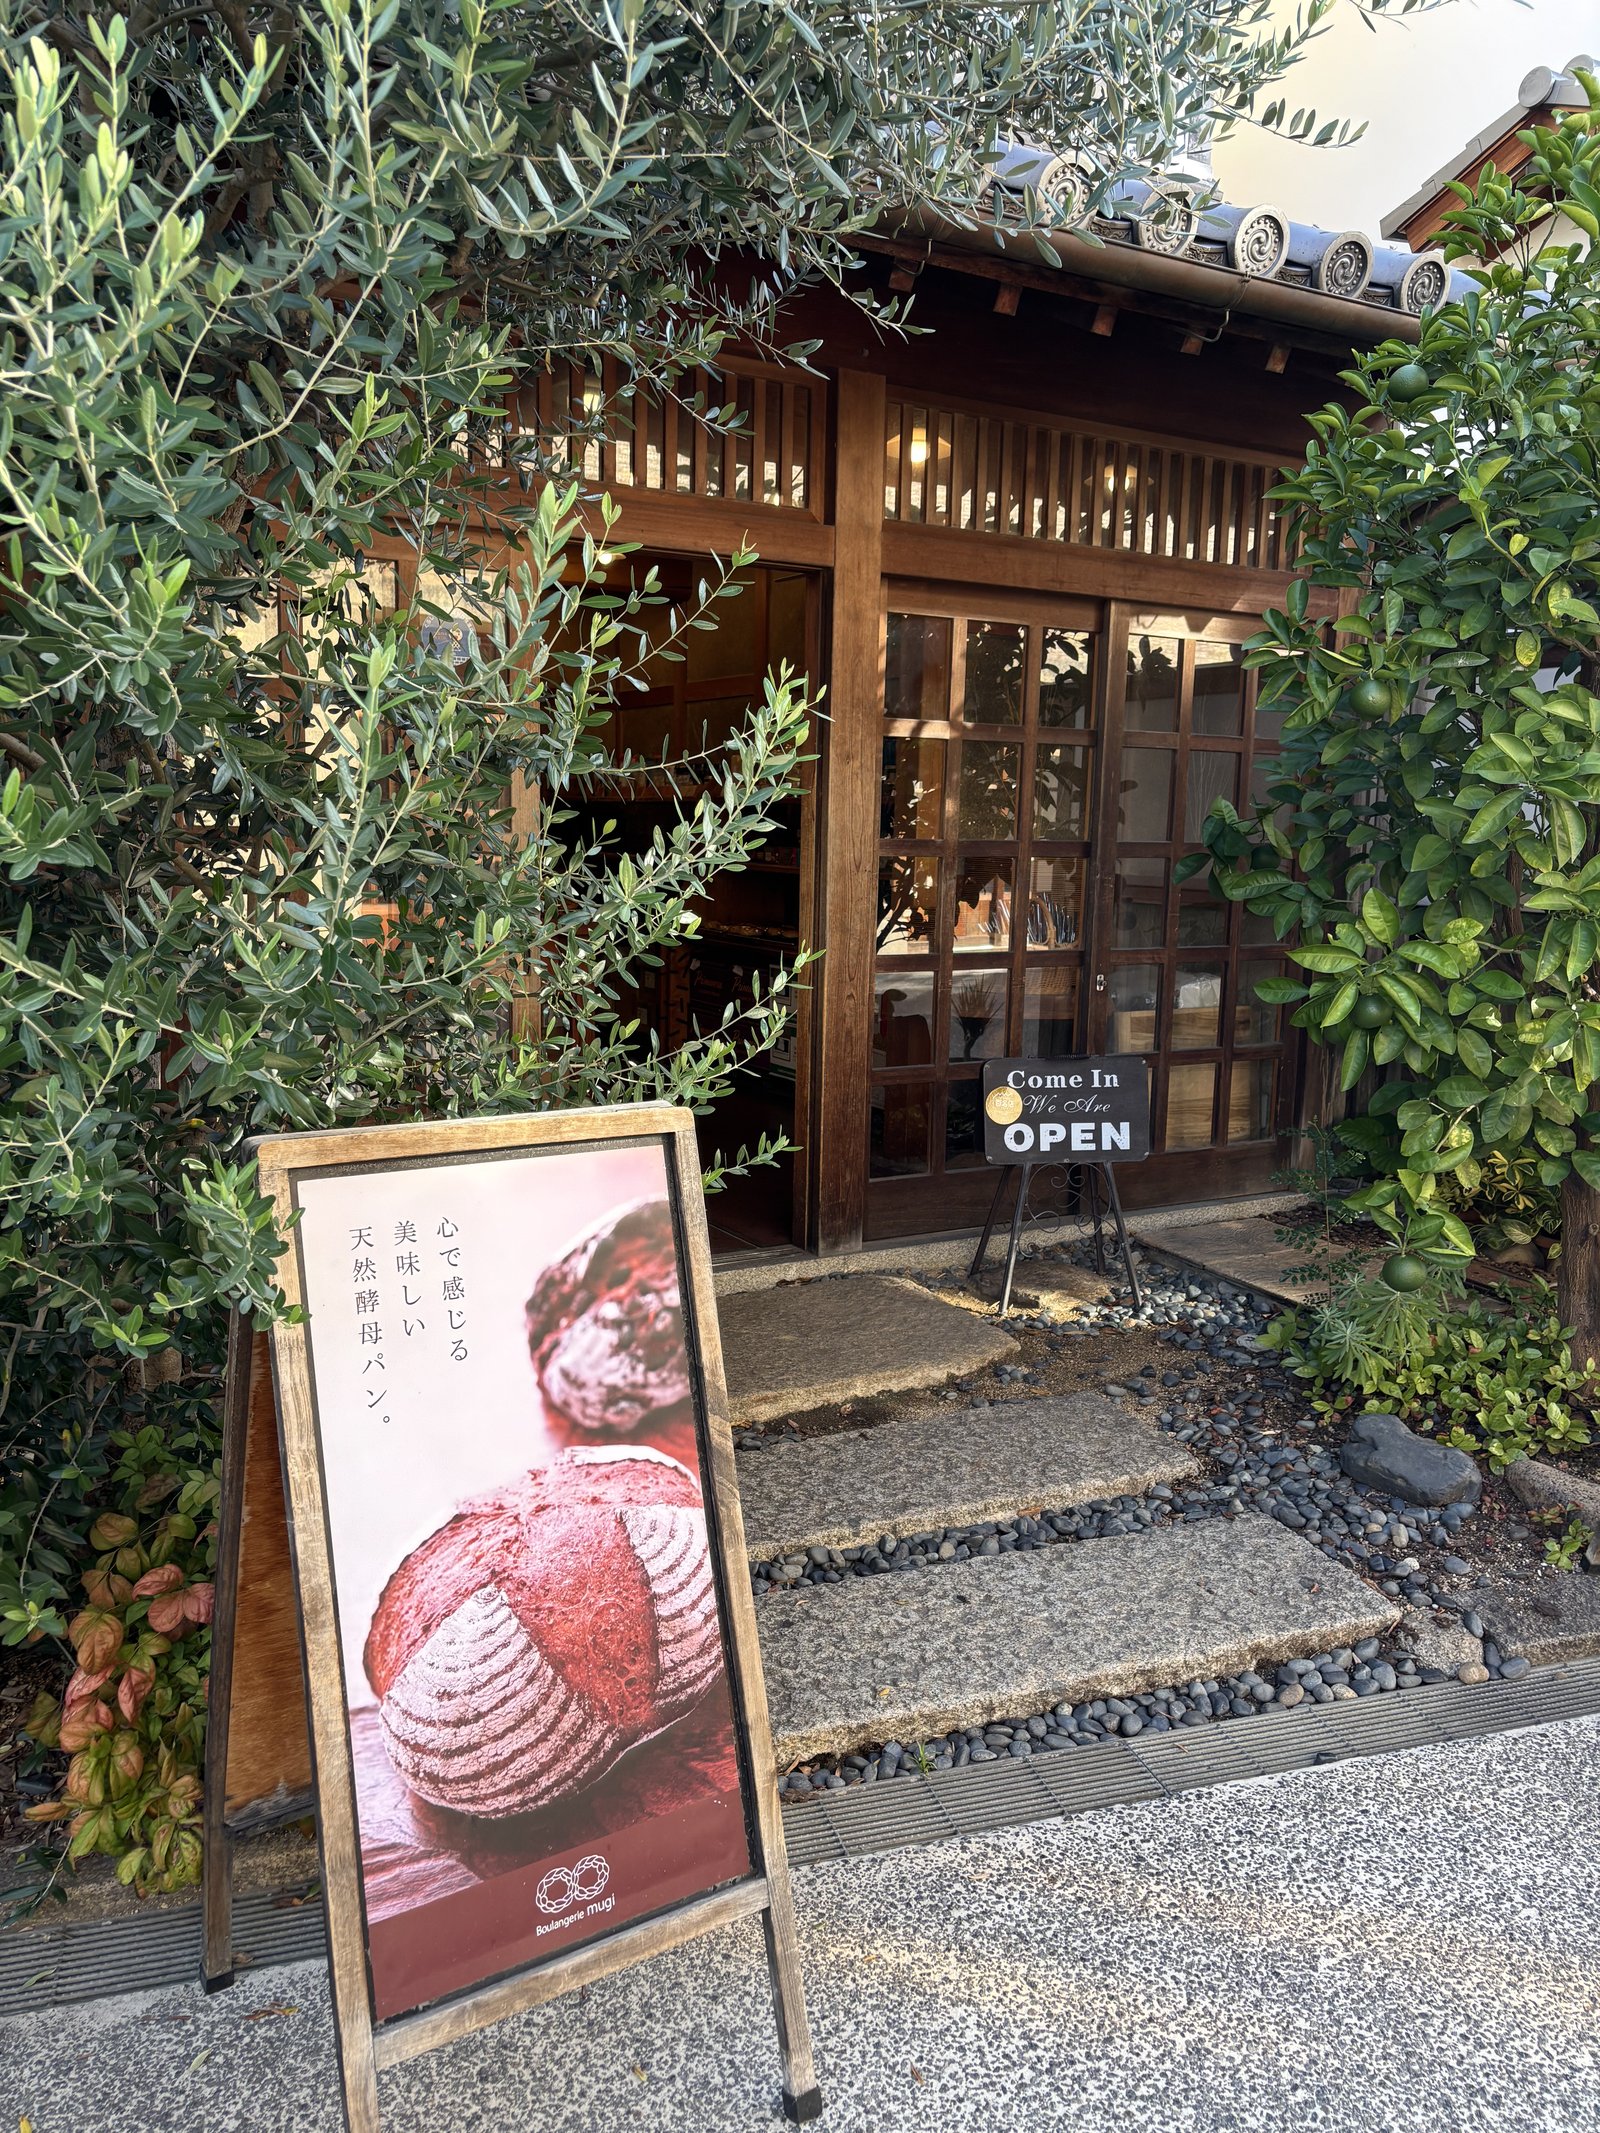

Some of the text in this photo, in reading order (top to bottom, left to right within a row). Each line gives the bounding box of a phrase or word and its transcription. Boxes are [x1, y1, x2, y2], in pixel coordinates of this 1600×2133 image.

[1007, 1069, 1120, 1089] Come In
[1023, 1094, 1057, 1114] We
[1063, 1094, 1111, 1113] Are
[1004, 1121, 1130, 1152] OPEN
[394, 1220, 425, 1337] 美味しい
[436, 1216, 468, 1362] 心で感じる
[349, 1226, 390, 1424] 天然酵母パン。
[536, 1893, 615, 1937] Boulangerie mugi
